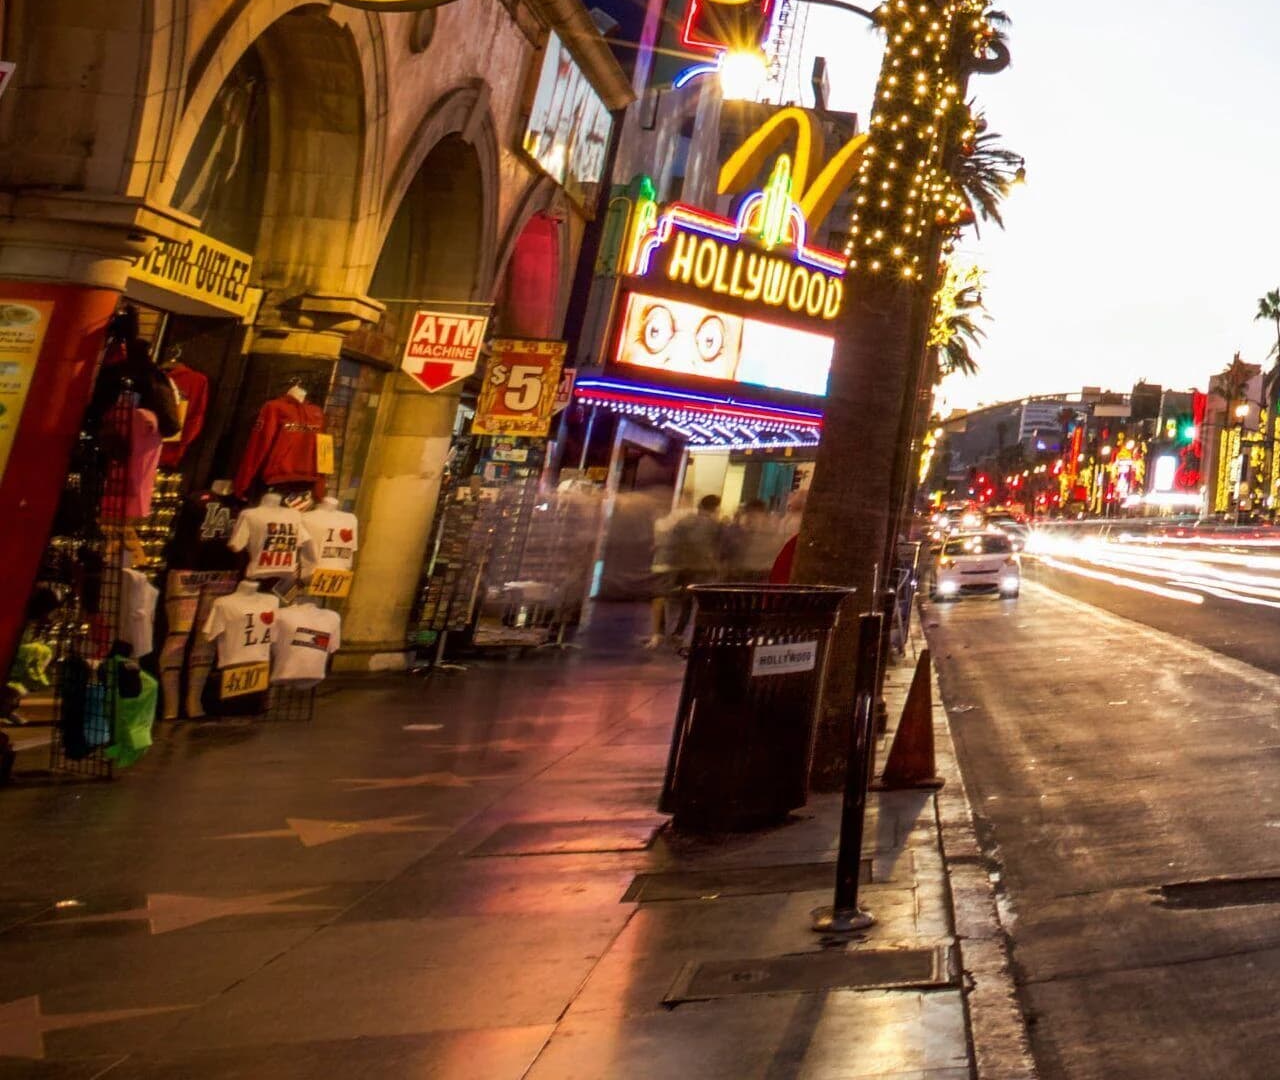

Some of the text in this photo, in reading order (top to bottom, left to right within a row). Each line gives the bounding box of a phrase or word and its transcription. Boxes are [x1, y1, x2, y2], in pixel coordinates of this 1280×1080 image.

[195, 244, 250, 304] OUTLET
[668, 230, 844, 320] HOLLYWOOD
[410, 342, 474, 360] MACHINE
[412, 317, 483, 348] ATM
[490, 363, 544, 412] $5
